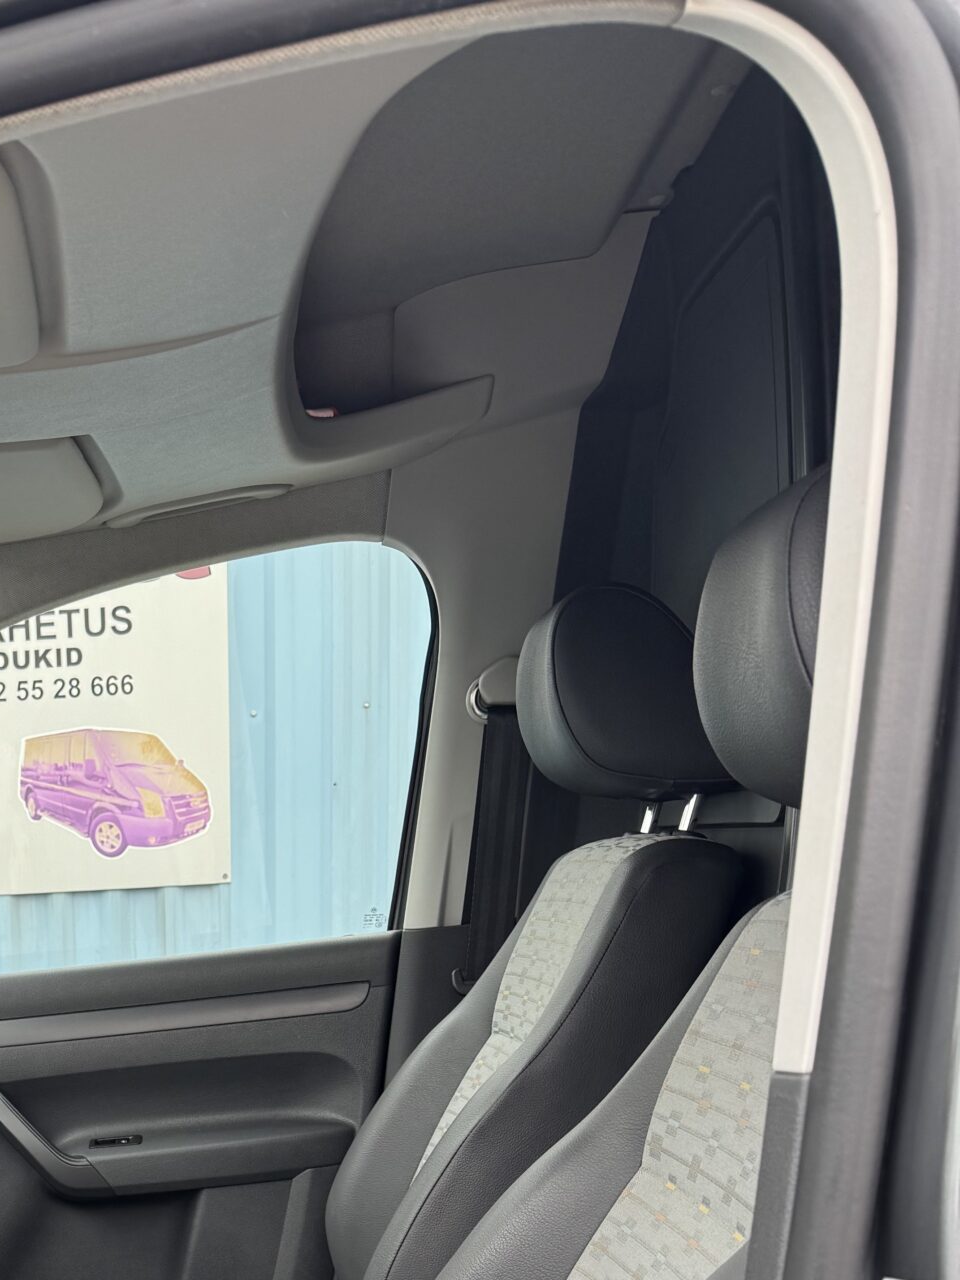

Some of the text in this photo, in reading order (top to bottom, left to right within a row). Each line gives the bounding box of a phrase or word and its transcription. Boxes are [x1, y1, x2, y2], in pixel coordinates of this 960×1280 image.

[16, 680, 44, 701] 55
[53, 677, 81, 698] 28
[91, 674, 134, 696] 666
